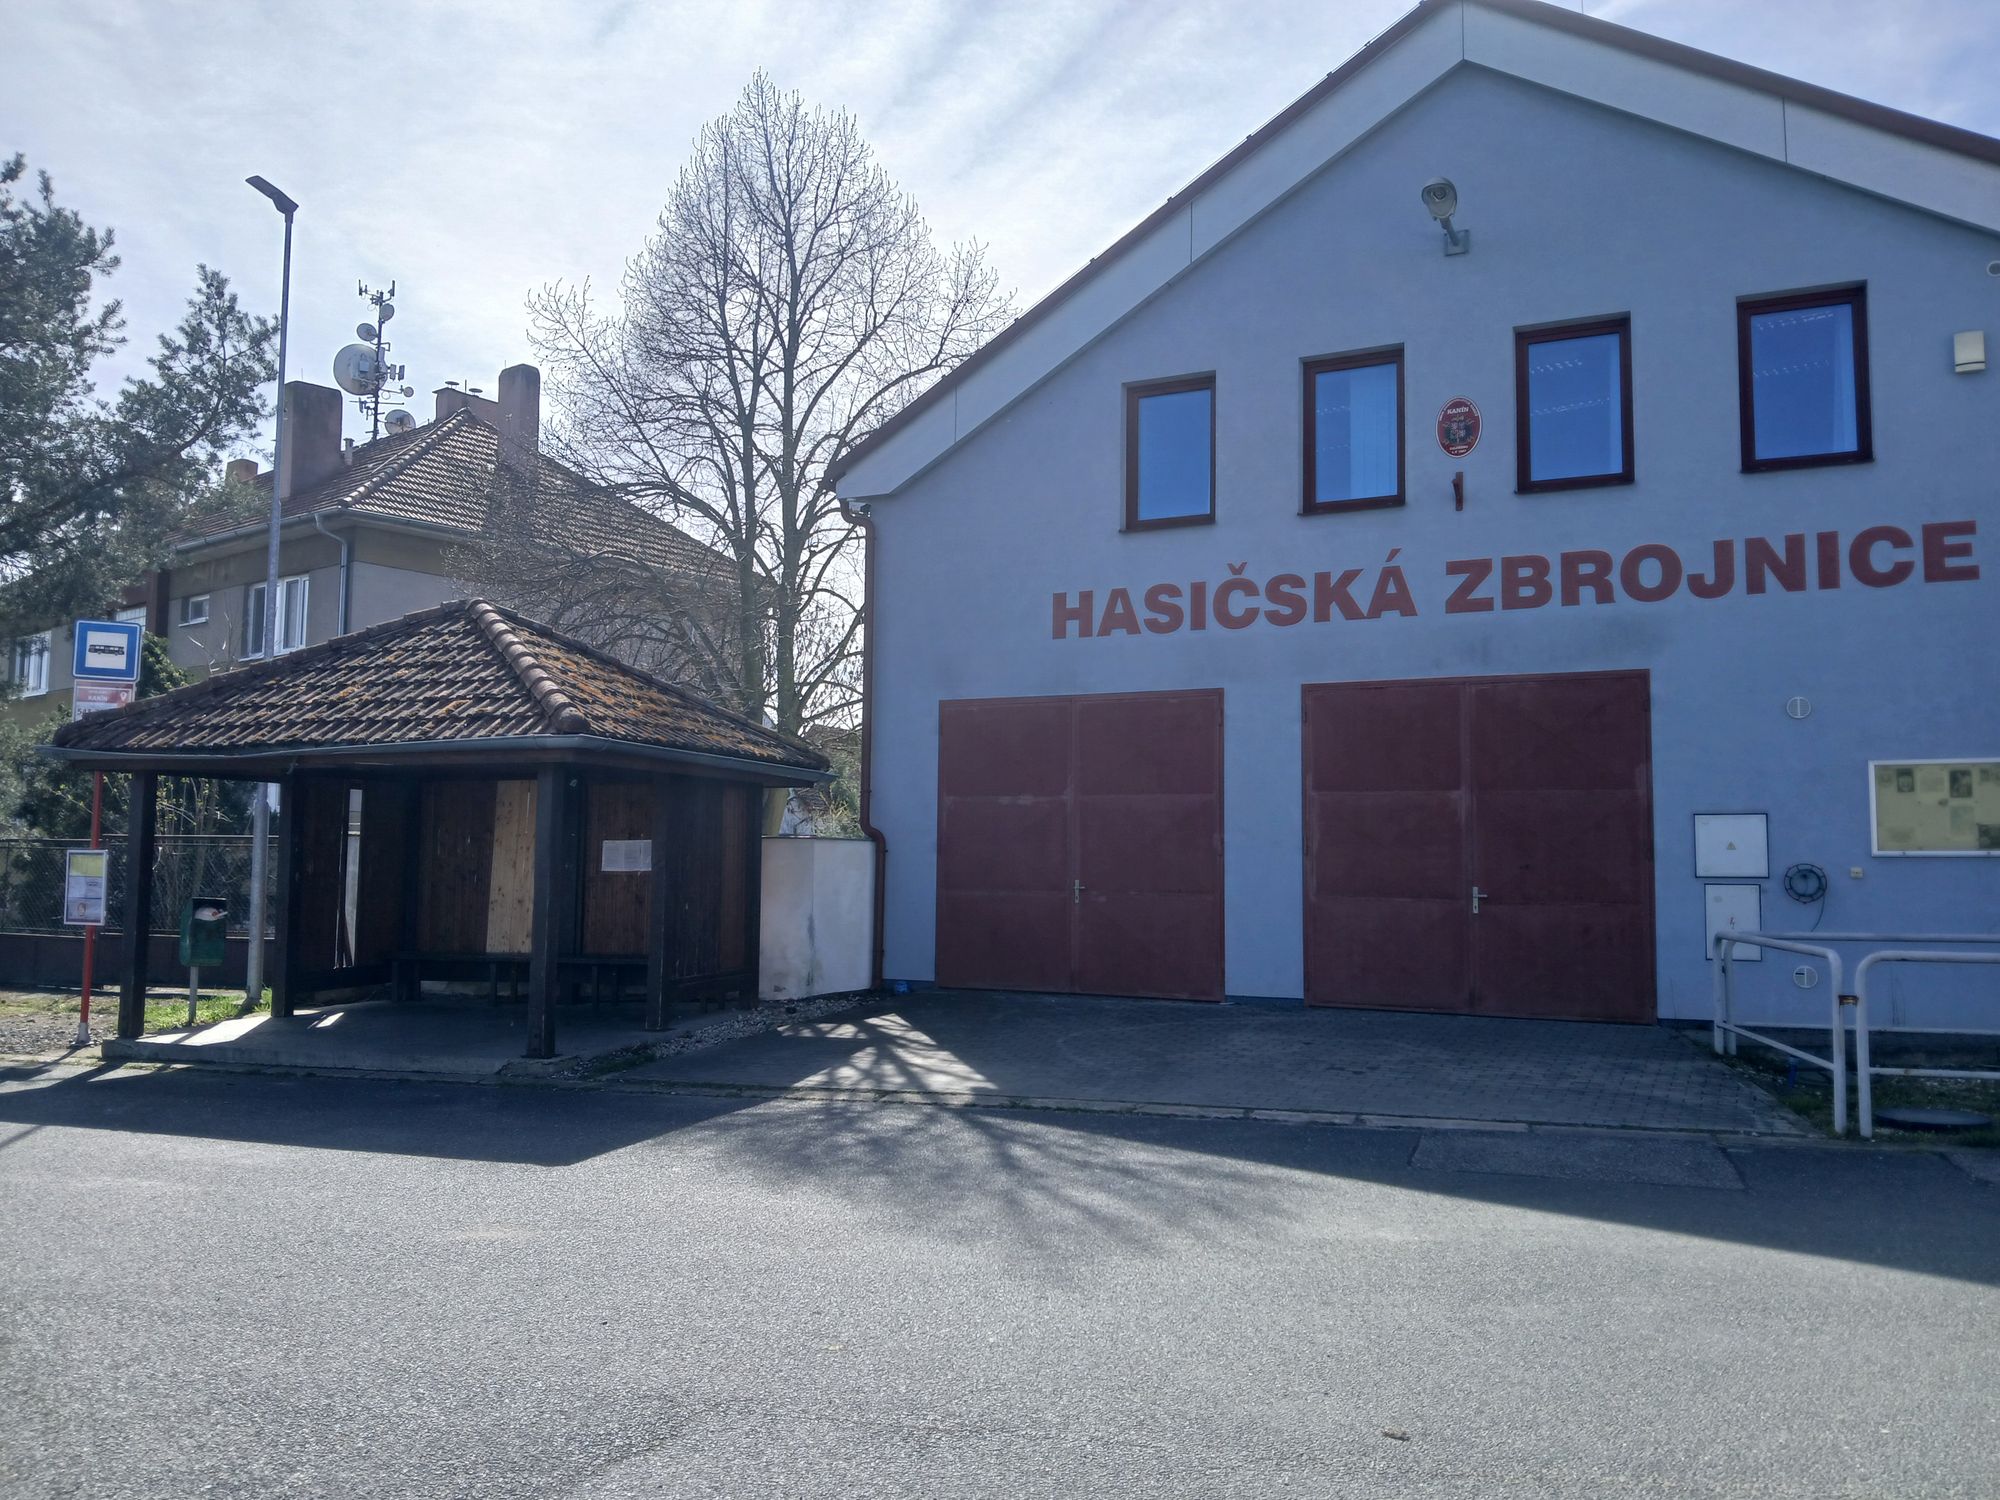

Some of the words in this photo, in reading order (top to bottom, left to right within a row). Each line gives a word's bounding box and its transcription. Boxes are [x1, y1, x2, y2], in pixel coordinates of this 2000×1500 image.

[1447, 406, 1469, 414] KANÍN
[1052, 548, 1418, 639] HASIČSKÁ
[1445, 520, 1980, 614] ZBROJNICE
